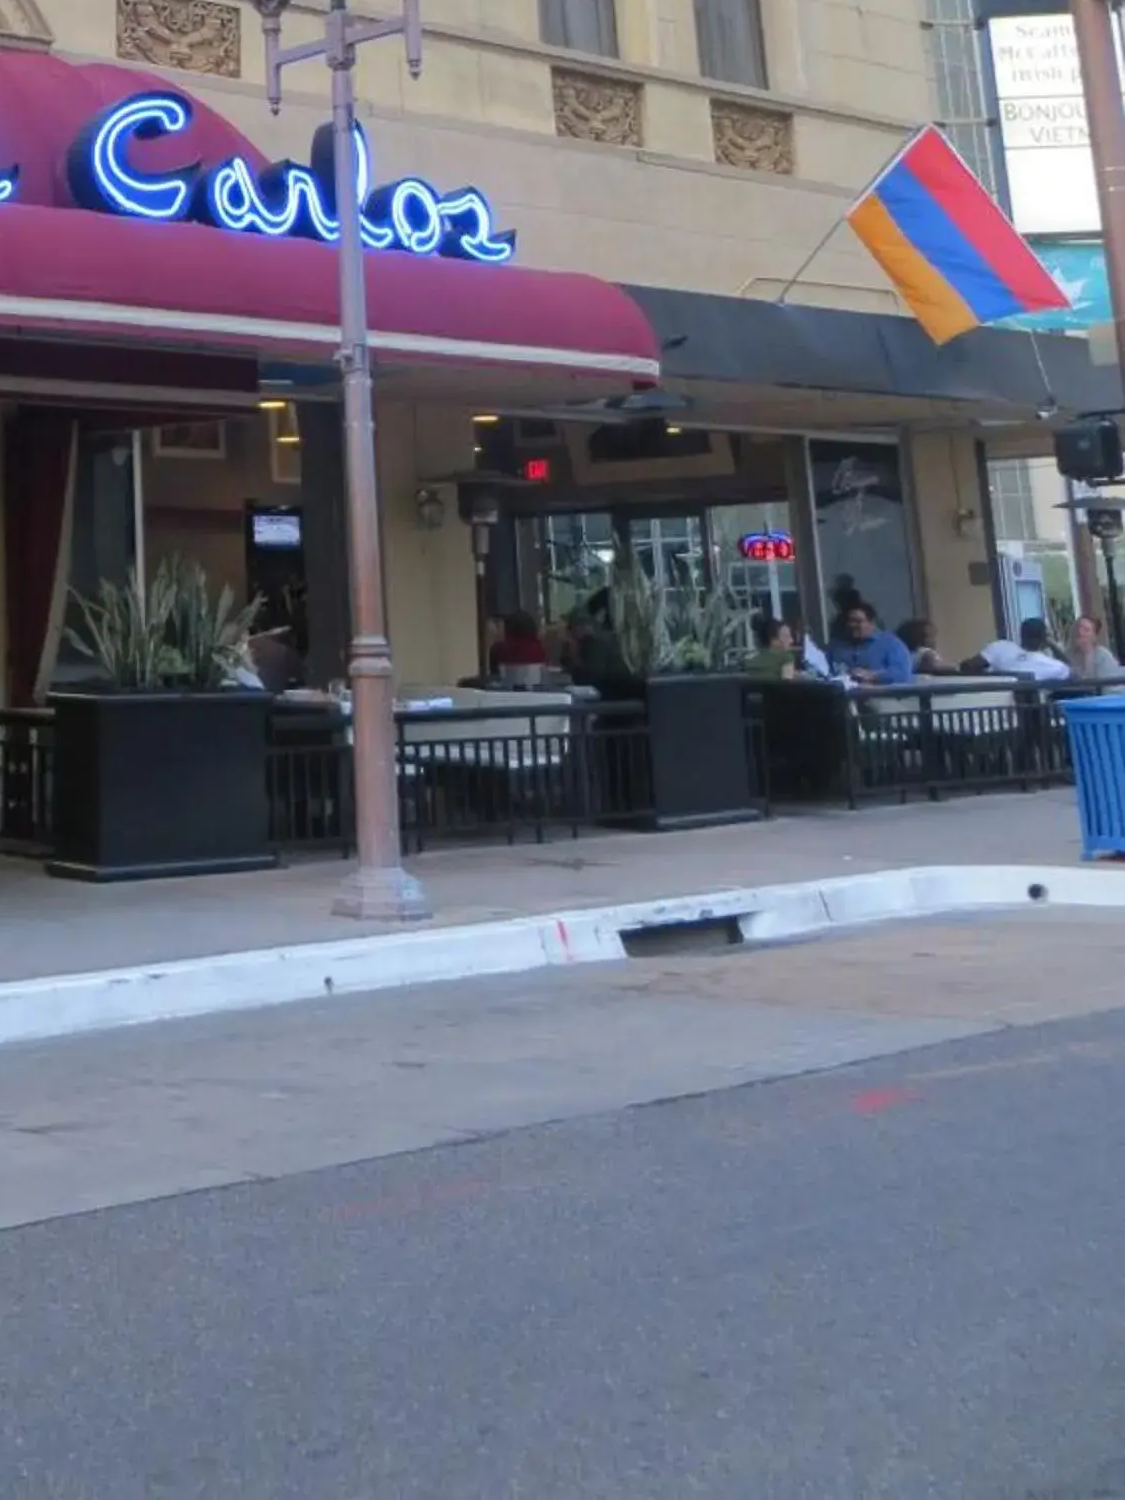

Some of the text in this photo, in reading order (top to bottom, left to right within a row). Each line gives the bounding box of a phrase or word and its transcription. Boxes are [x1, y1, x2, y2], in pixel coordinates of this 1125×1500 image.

[1003, 101, 1084, 121] BONJOU
[1030, 126, 1089, 143] VIETN
[77, 90, 515, 265] Carlos
